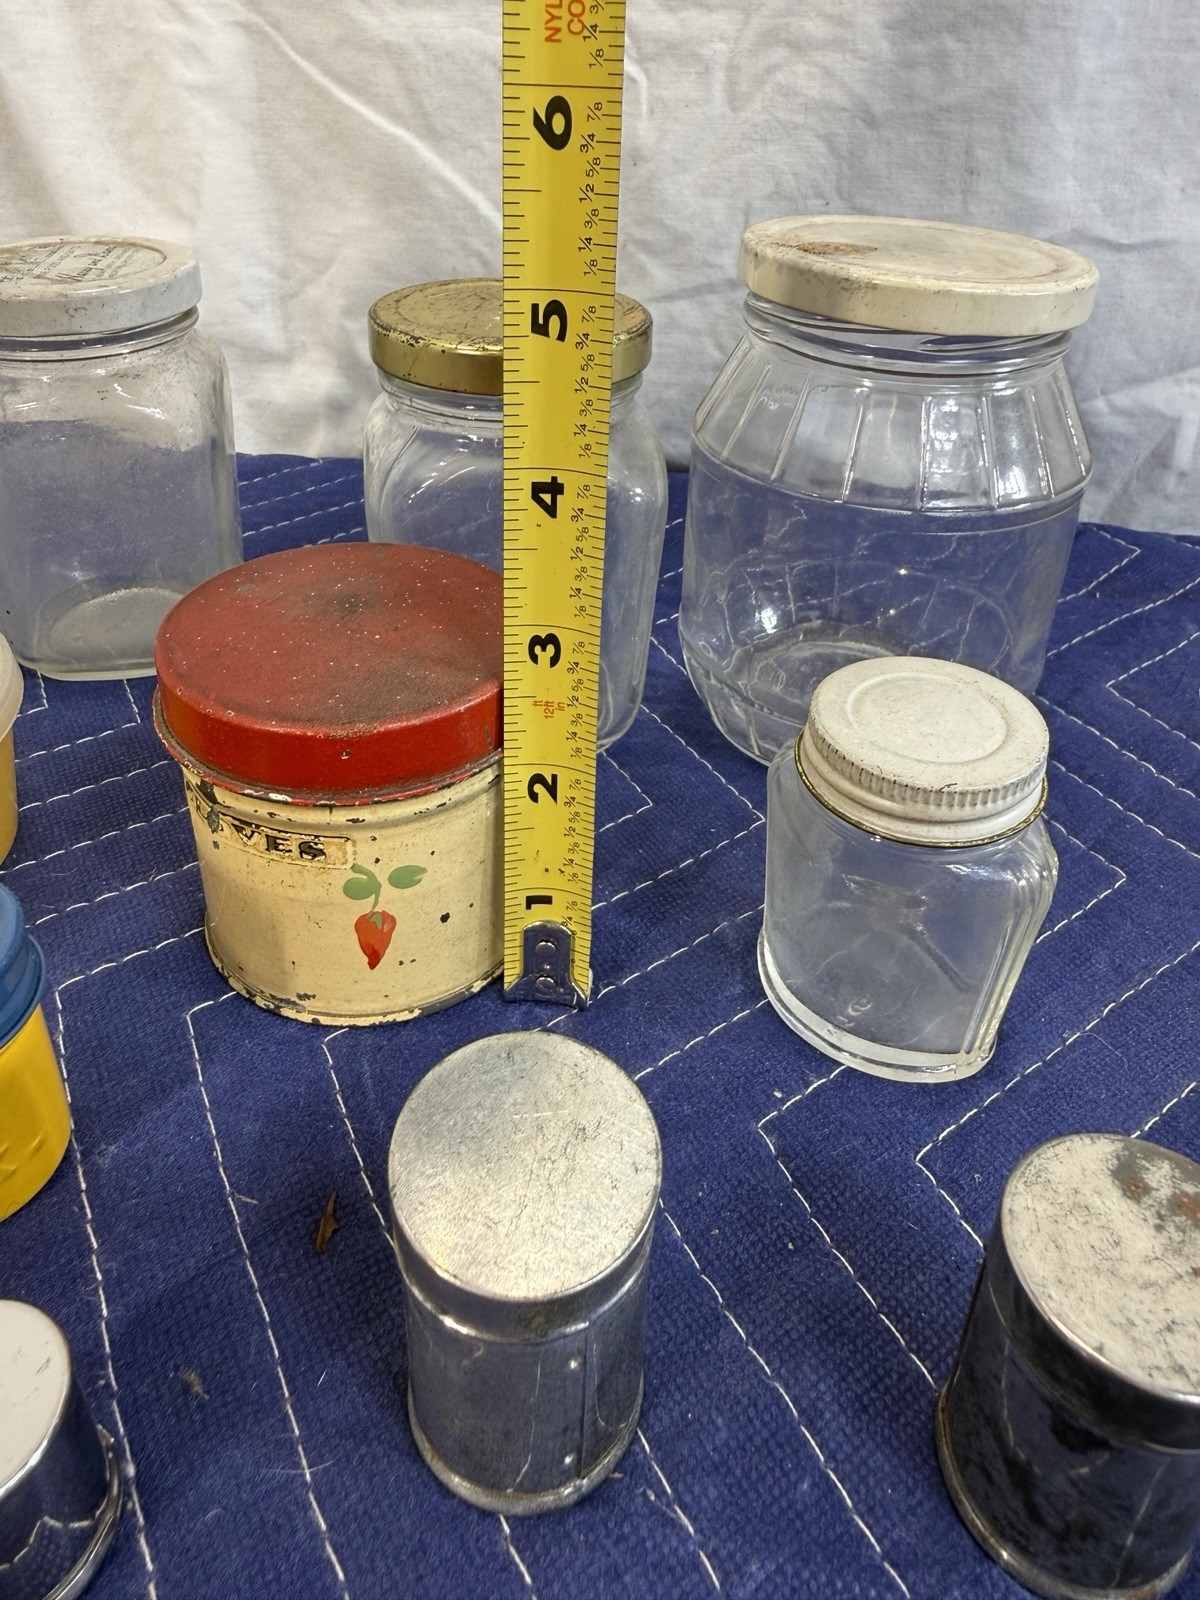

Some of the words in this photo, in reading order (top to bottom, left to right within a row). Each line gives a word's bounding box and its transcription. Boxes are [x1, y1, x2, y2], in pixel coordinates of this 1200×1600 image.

[581, 20, 599, 42] 1/4
[589, 48, 604, 68] 1/8
[587, 101, 603, 122] 7/8
[533, 95, 572, 151] 6
[580, 133, 596, 153] 3/4
[586, 157, 601, 178] 5/8
[579, 184, 595, 204] 1/2
[584, 208, 600, 229] 3/8
[578, 237, 593, 253] 1/4
[583, 259, 598, 277] 1/8
[531, 300, 567, 343] 5
[581, 306, 597, 323] 7/8
[575, 332, 590, 350] 3/4
[581, 354, 595, 371] 5/8
[574, 376, 589, 394] 1/2
[579, 398, 593, 417] 3/8
[573, 423, 587, 438] 1/4
[578, 443, 592, 458] 1/8
[531, 475, 565, 519] 4
[577, 484, 591, 500] 7/8
[571, 507, 585, 522] 3/4
[576, 526, 589, 543] 5/8
[570, 546, 585, 562] 1/2
[574, 566, 588, 581] 3/8
[569, 586, 583, 601] 1/4
[574, 605, 587, 618] 1/8
[528, 632, 561, 669] 3
[572, 641, 585, 655] 7/8
[567, 661, 580, 674] 3/4
[571, 679, 584, 692] 5/8
[566, 695, 579, 708] 1/2
[570, 713, 584, 727] 3/8
[566, 730, 578, 742] 1/4
[570, 747, 583, 759] 1/8
[527, 773, 558, 806] 2
[569, 778, 582, 791] 7/8
[563, 796, 577, 808] 3/4
[568, 811, 581, 824] 5/8
[563, 826, 576, 839] 1/2
[567, 842, 580, 854] 3/8
[563, 857, 575, 869] 1/4
[567, 872, 579, 884] 1/8
[525, 895, 553, 910] 1
